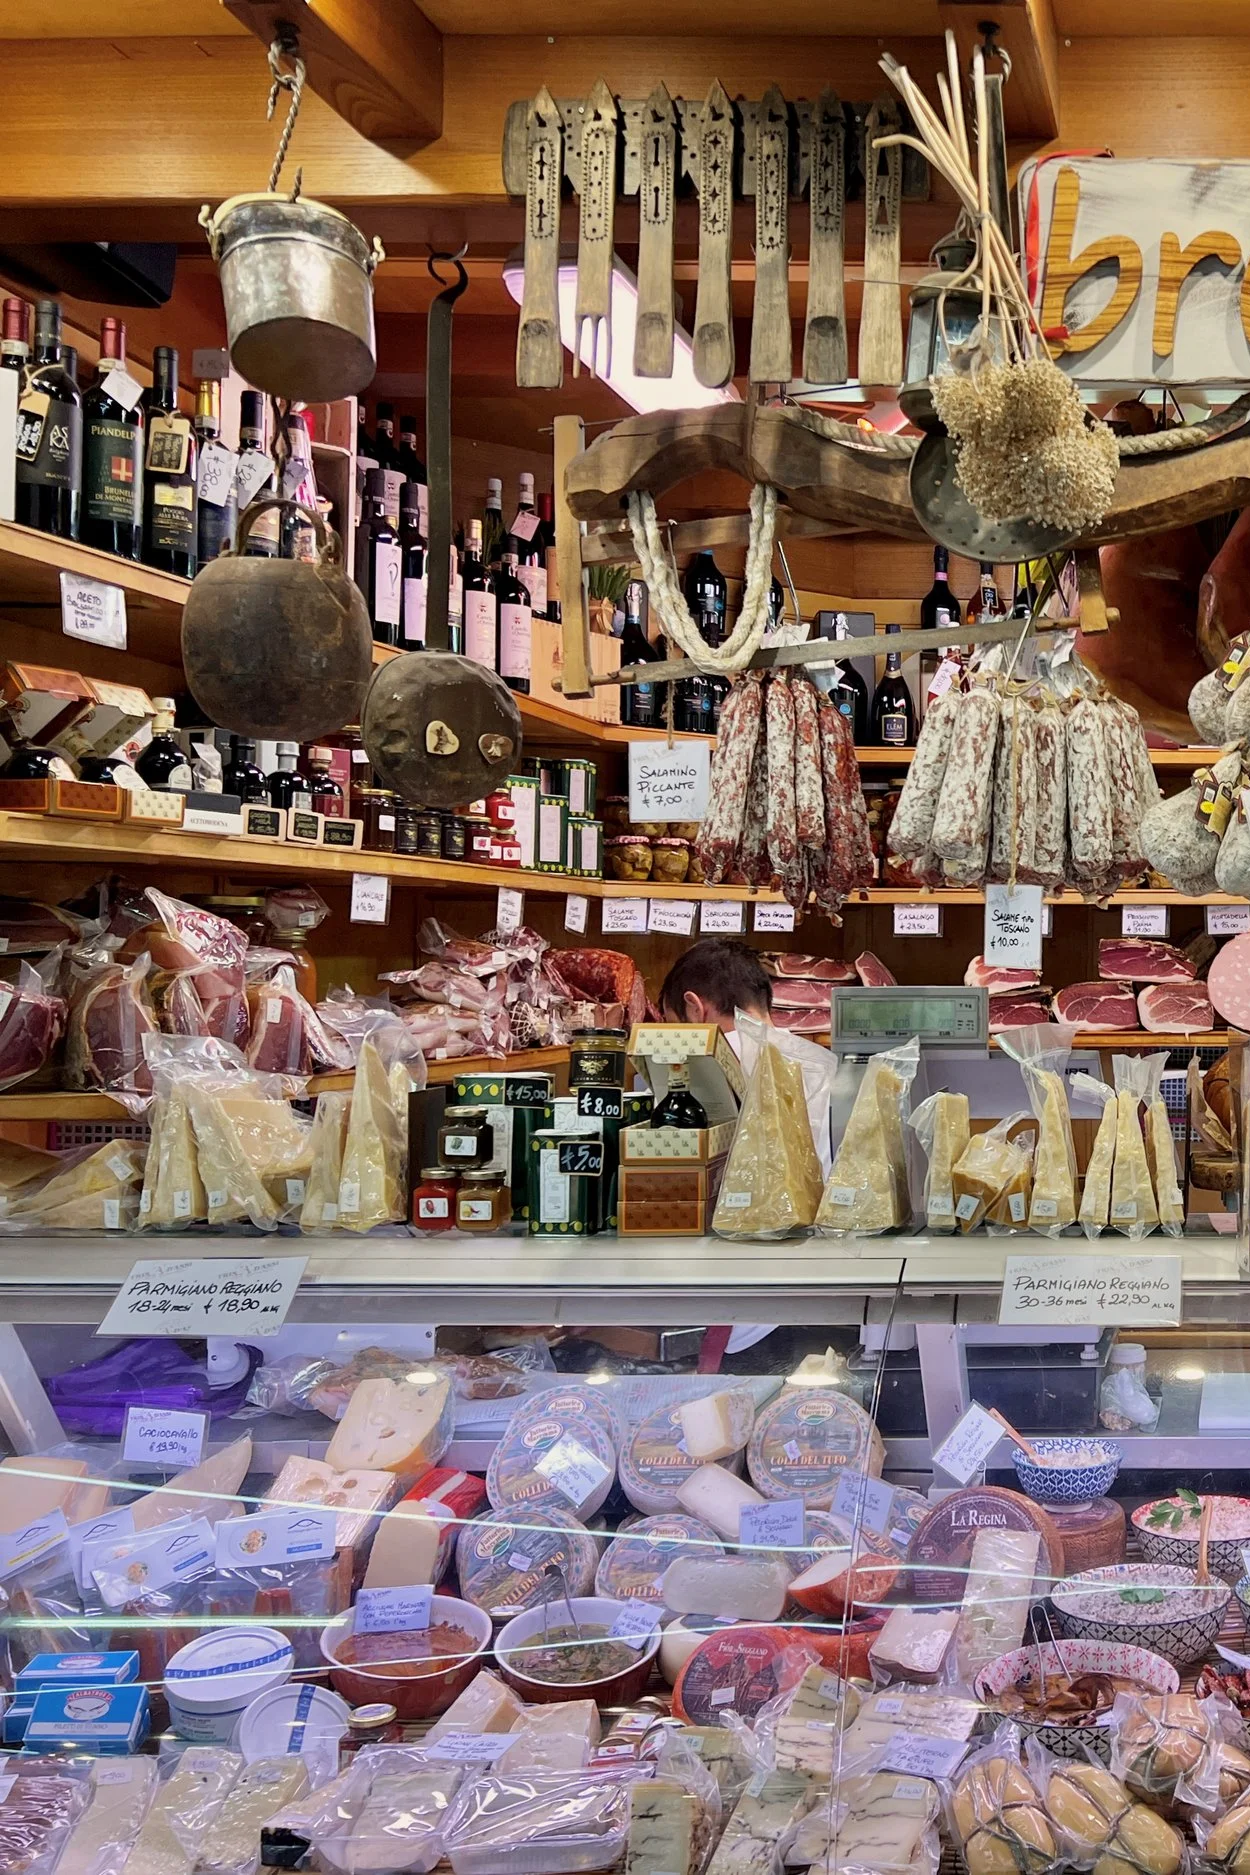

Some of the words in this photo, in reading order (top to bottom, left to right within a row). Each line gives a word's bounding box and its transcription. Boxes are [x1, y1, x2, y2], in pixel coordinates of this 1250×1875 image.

[640, 765, 696, 778] SALAMINO
[636, 781, 694, 793] PICCANTE
[654, 796, 682, 807] 7,00
[992, 909, 1020, 923] SALAME
[996, 922, 1030, 934] TOSCANO
[128, 1280, 218, 1296] PARMIGIANO
[219, 1279, 282, 1295] REGGIANO
[1012, 1275, 1106, 1292] PARMIGIANO
[1109, 1277, 1170, 1291] REGGIANO
[128, 1299, 171, 1314] 18-24
[218, 1298, 260, 1314] 18,90
[1015, 1296, 1064, 1309] 30-36
[1065, 1296, 1088, 1306] mesi
[1108, 1294, 1150, 1307] 22,90
[640, 1456, 671, 1466] COLLI
[802, 1455, 820, 1464] DEL
[822, 1455, 847, 1464] TUFO
[951, 1510, 966, 1526] LA
[968, 1510, 1007, 1526] REGINA
